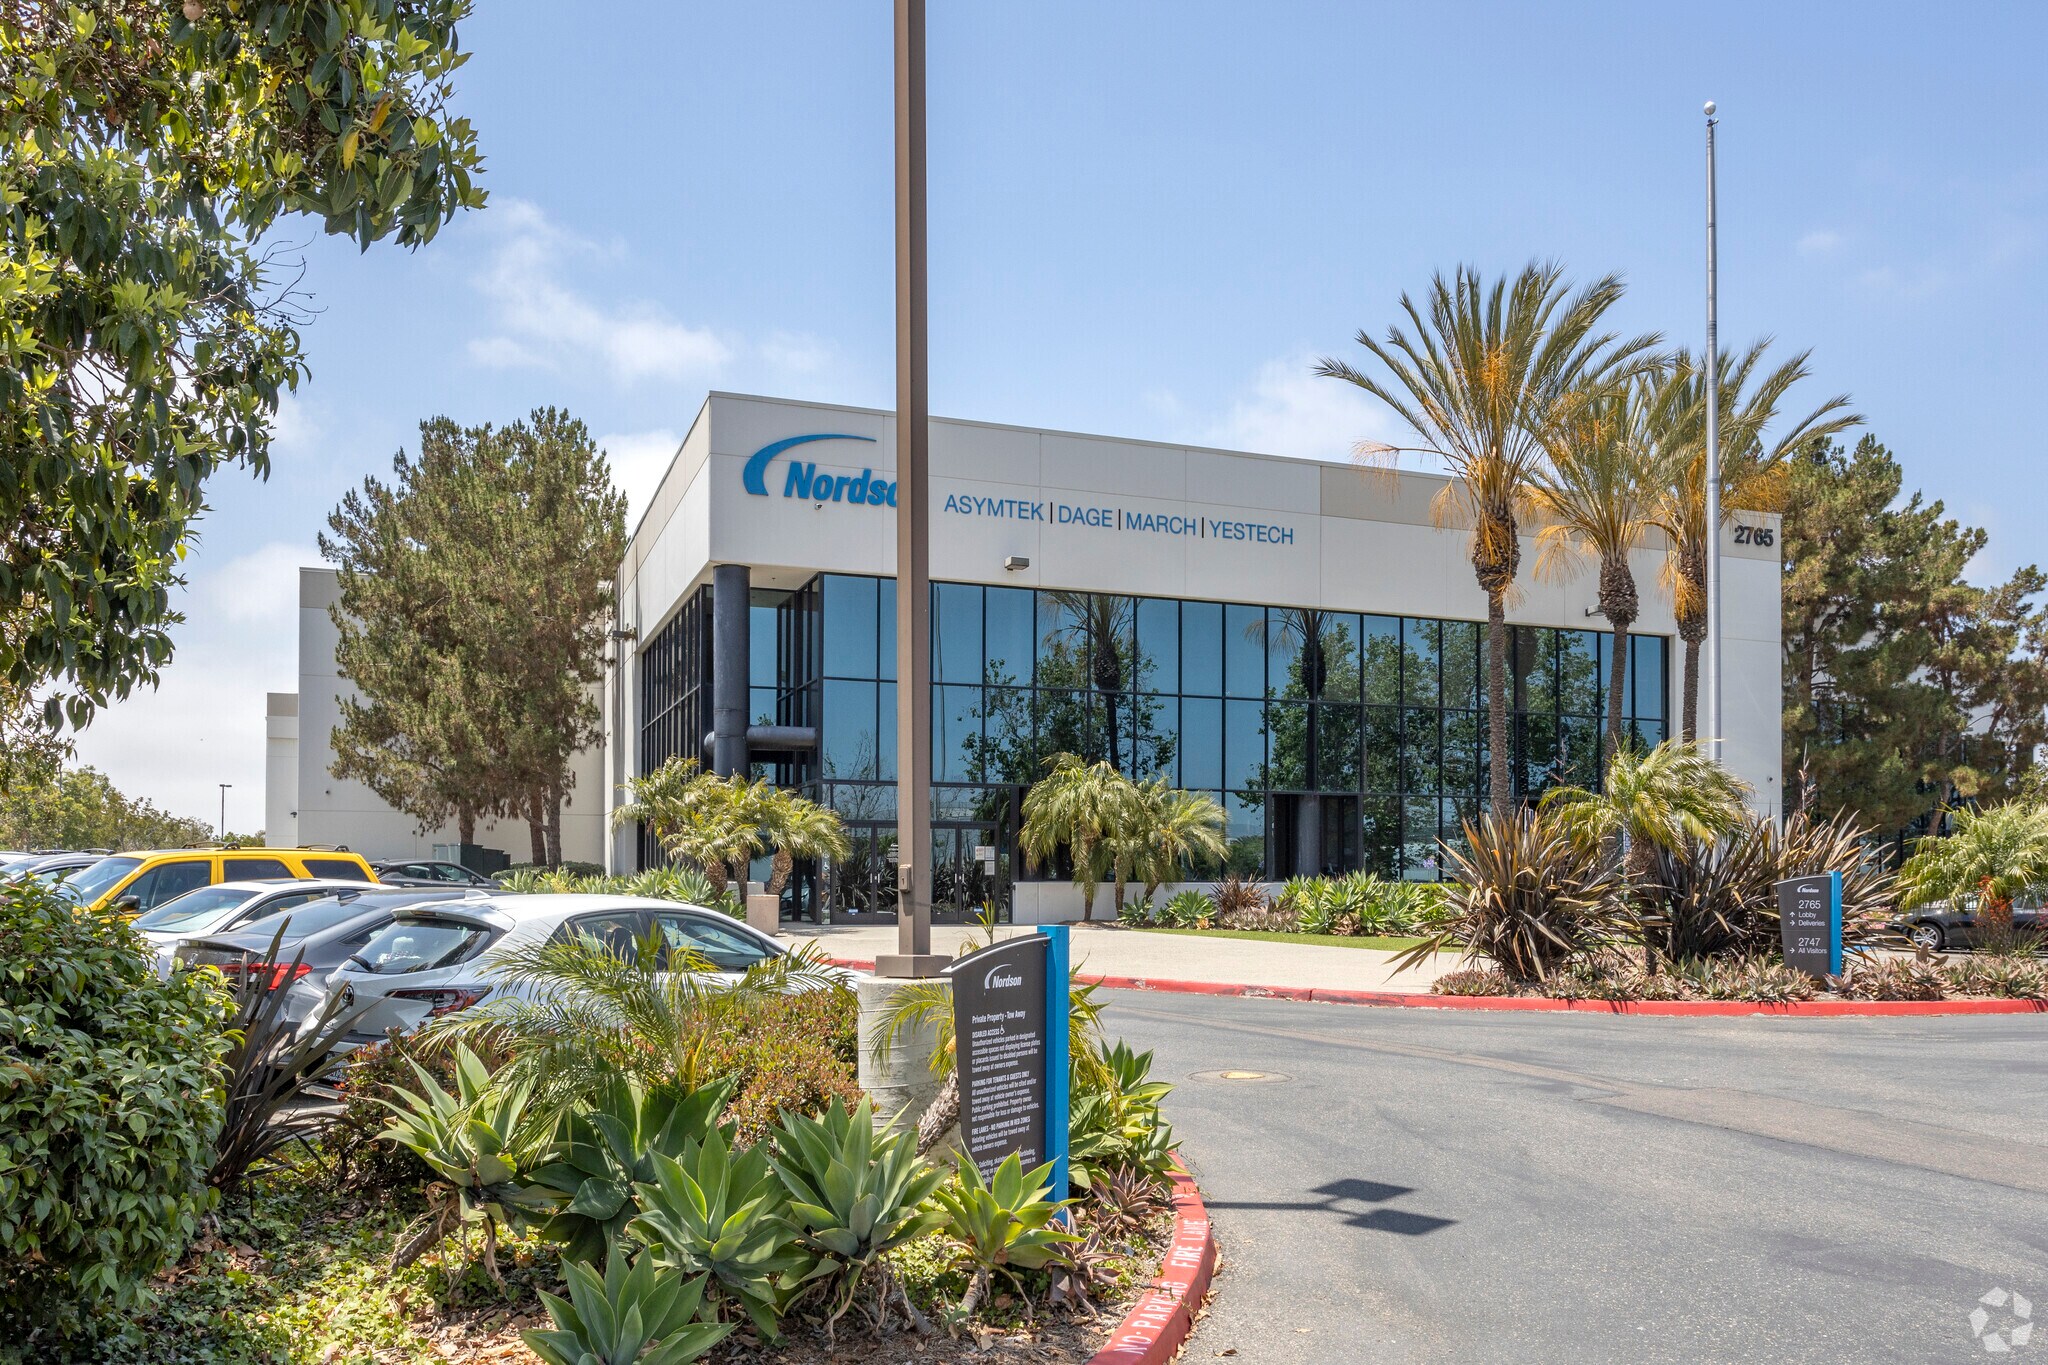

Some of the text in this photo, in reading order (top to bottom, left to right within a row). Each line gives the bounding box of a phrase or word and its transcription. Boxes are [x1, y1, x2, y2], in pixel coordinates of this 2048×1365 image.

[784, 461, 897, 508] Nords
[944, 494, 1294, 545] ASYMTEK DAGE MARCH YESTECH
[1734, 525, 1774, 547] 2765
[1798, 900, 1821, 909] 2765
[1798, 911, 1817, 919] Lobby
[1798, 937, 1821, 947] 2747
[992, 974, 1022, 988] Nordson
[1115, 1219, 1208, 1355] NO PARKING FIRE LANE
